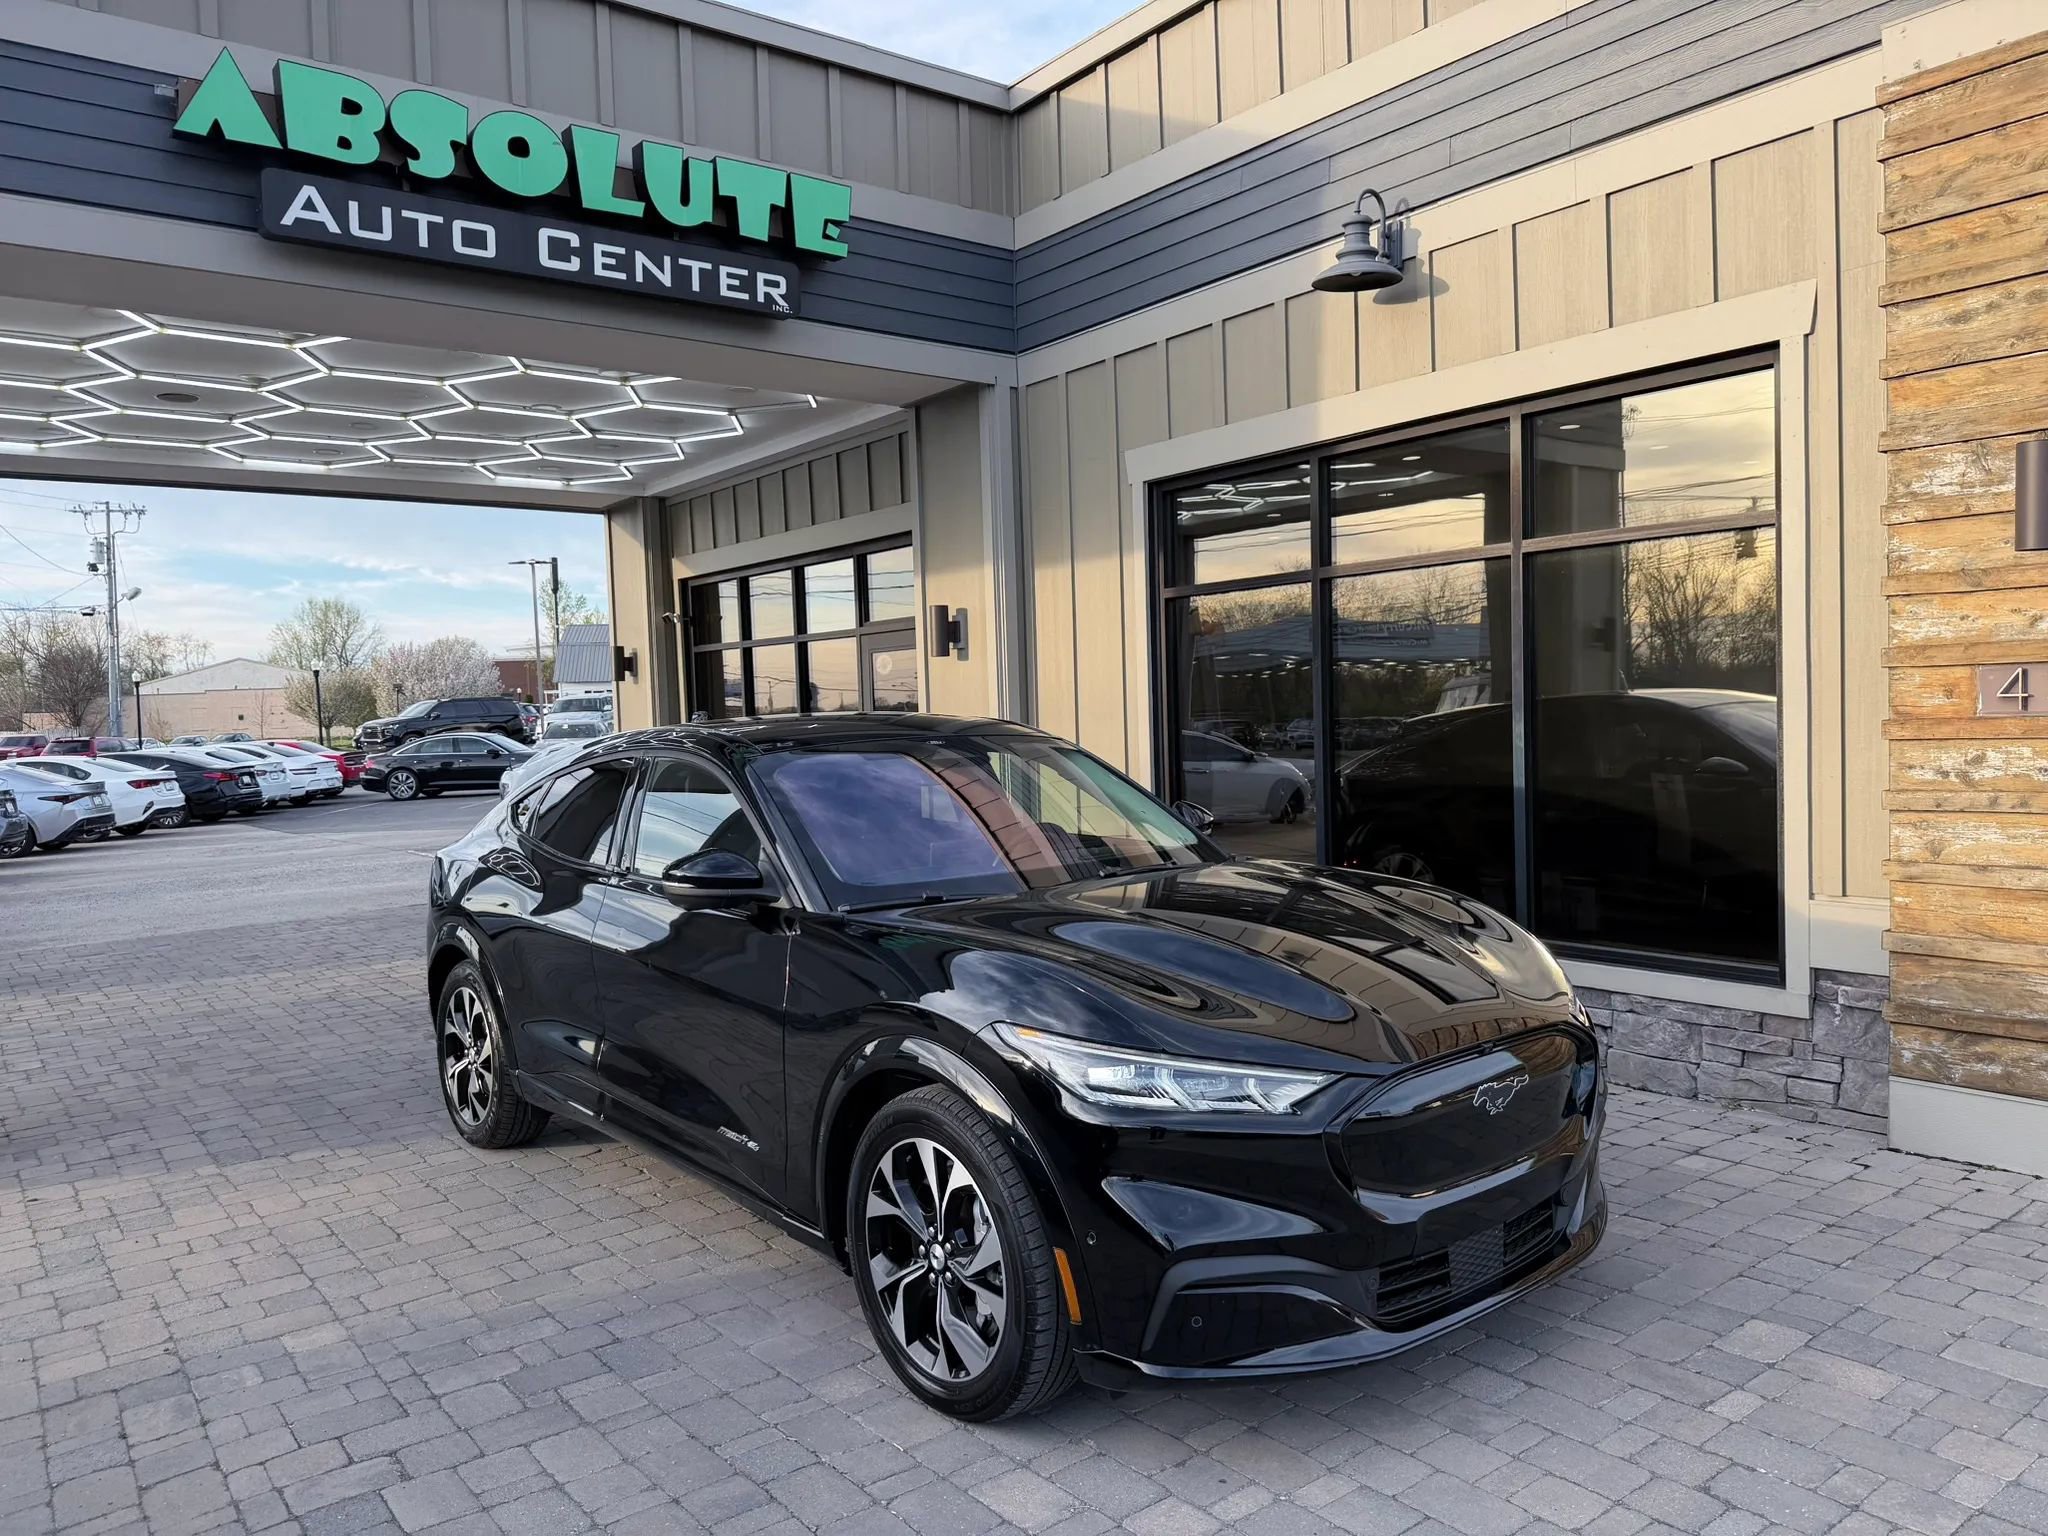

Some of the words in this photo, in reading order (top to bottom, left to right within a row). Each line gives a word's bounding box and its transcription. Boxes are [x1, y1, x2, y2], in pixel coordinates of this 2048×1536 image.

[173, 46, 852, 259] ABSOLUTE
[279, 184, 497, 259] AUTO
[538, 226, 789, 307] CENTER
[772, 304, 793, 314] INC.
[1996, 667, 2029, 711] 4
